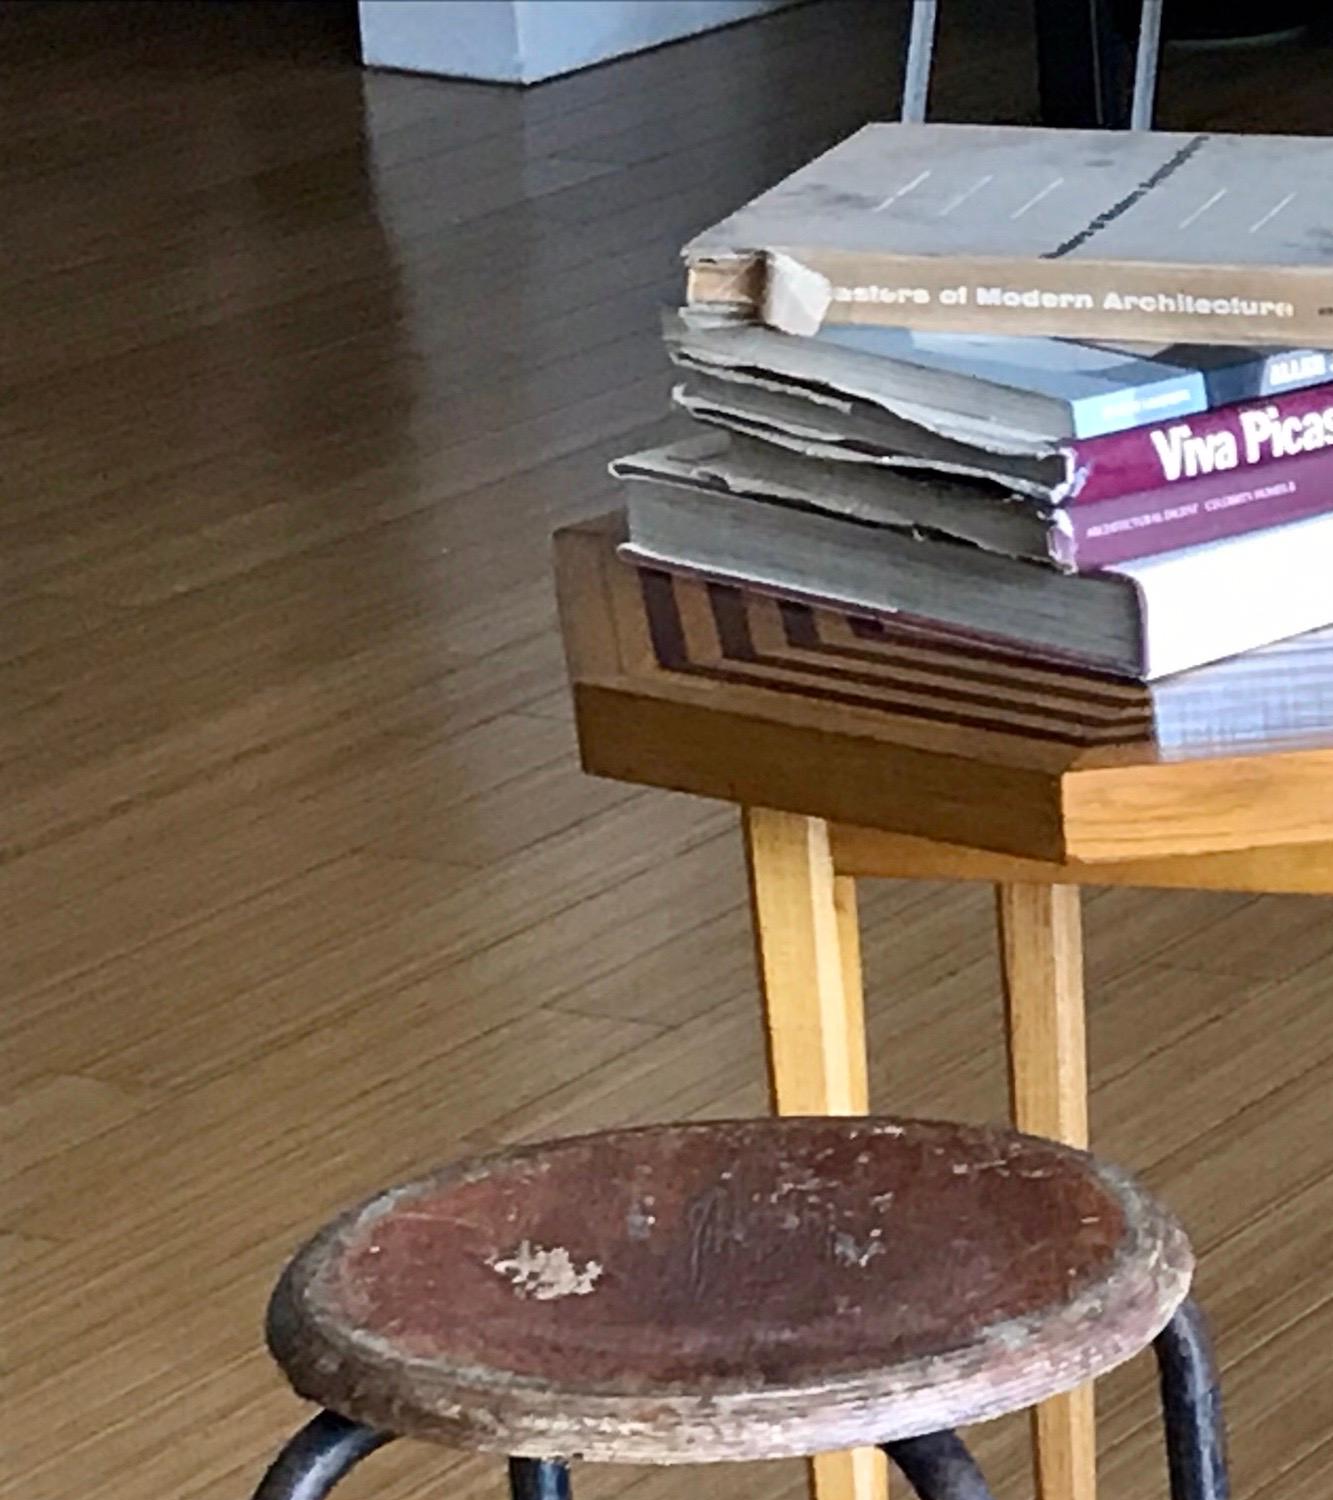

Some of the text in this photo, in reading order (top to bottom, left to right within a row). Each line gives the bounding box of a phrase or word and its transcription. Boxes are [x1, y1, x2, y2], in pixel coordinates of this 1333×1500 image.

[833, 285, 930, 304] asters
[938, 285, 968, 305] of
[976, 286, 1093, 308] Modern
[1103, 291, 1295, 318] Architecture
[1150, 422, 1239, 481] Viva
